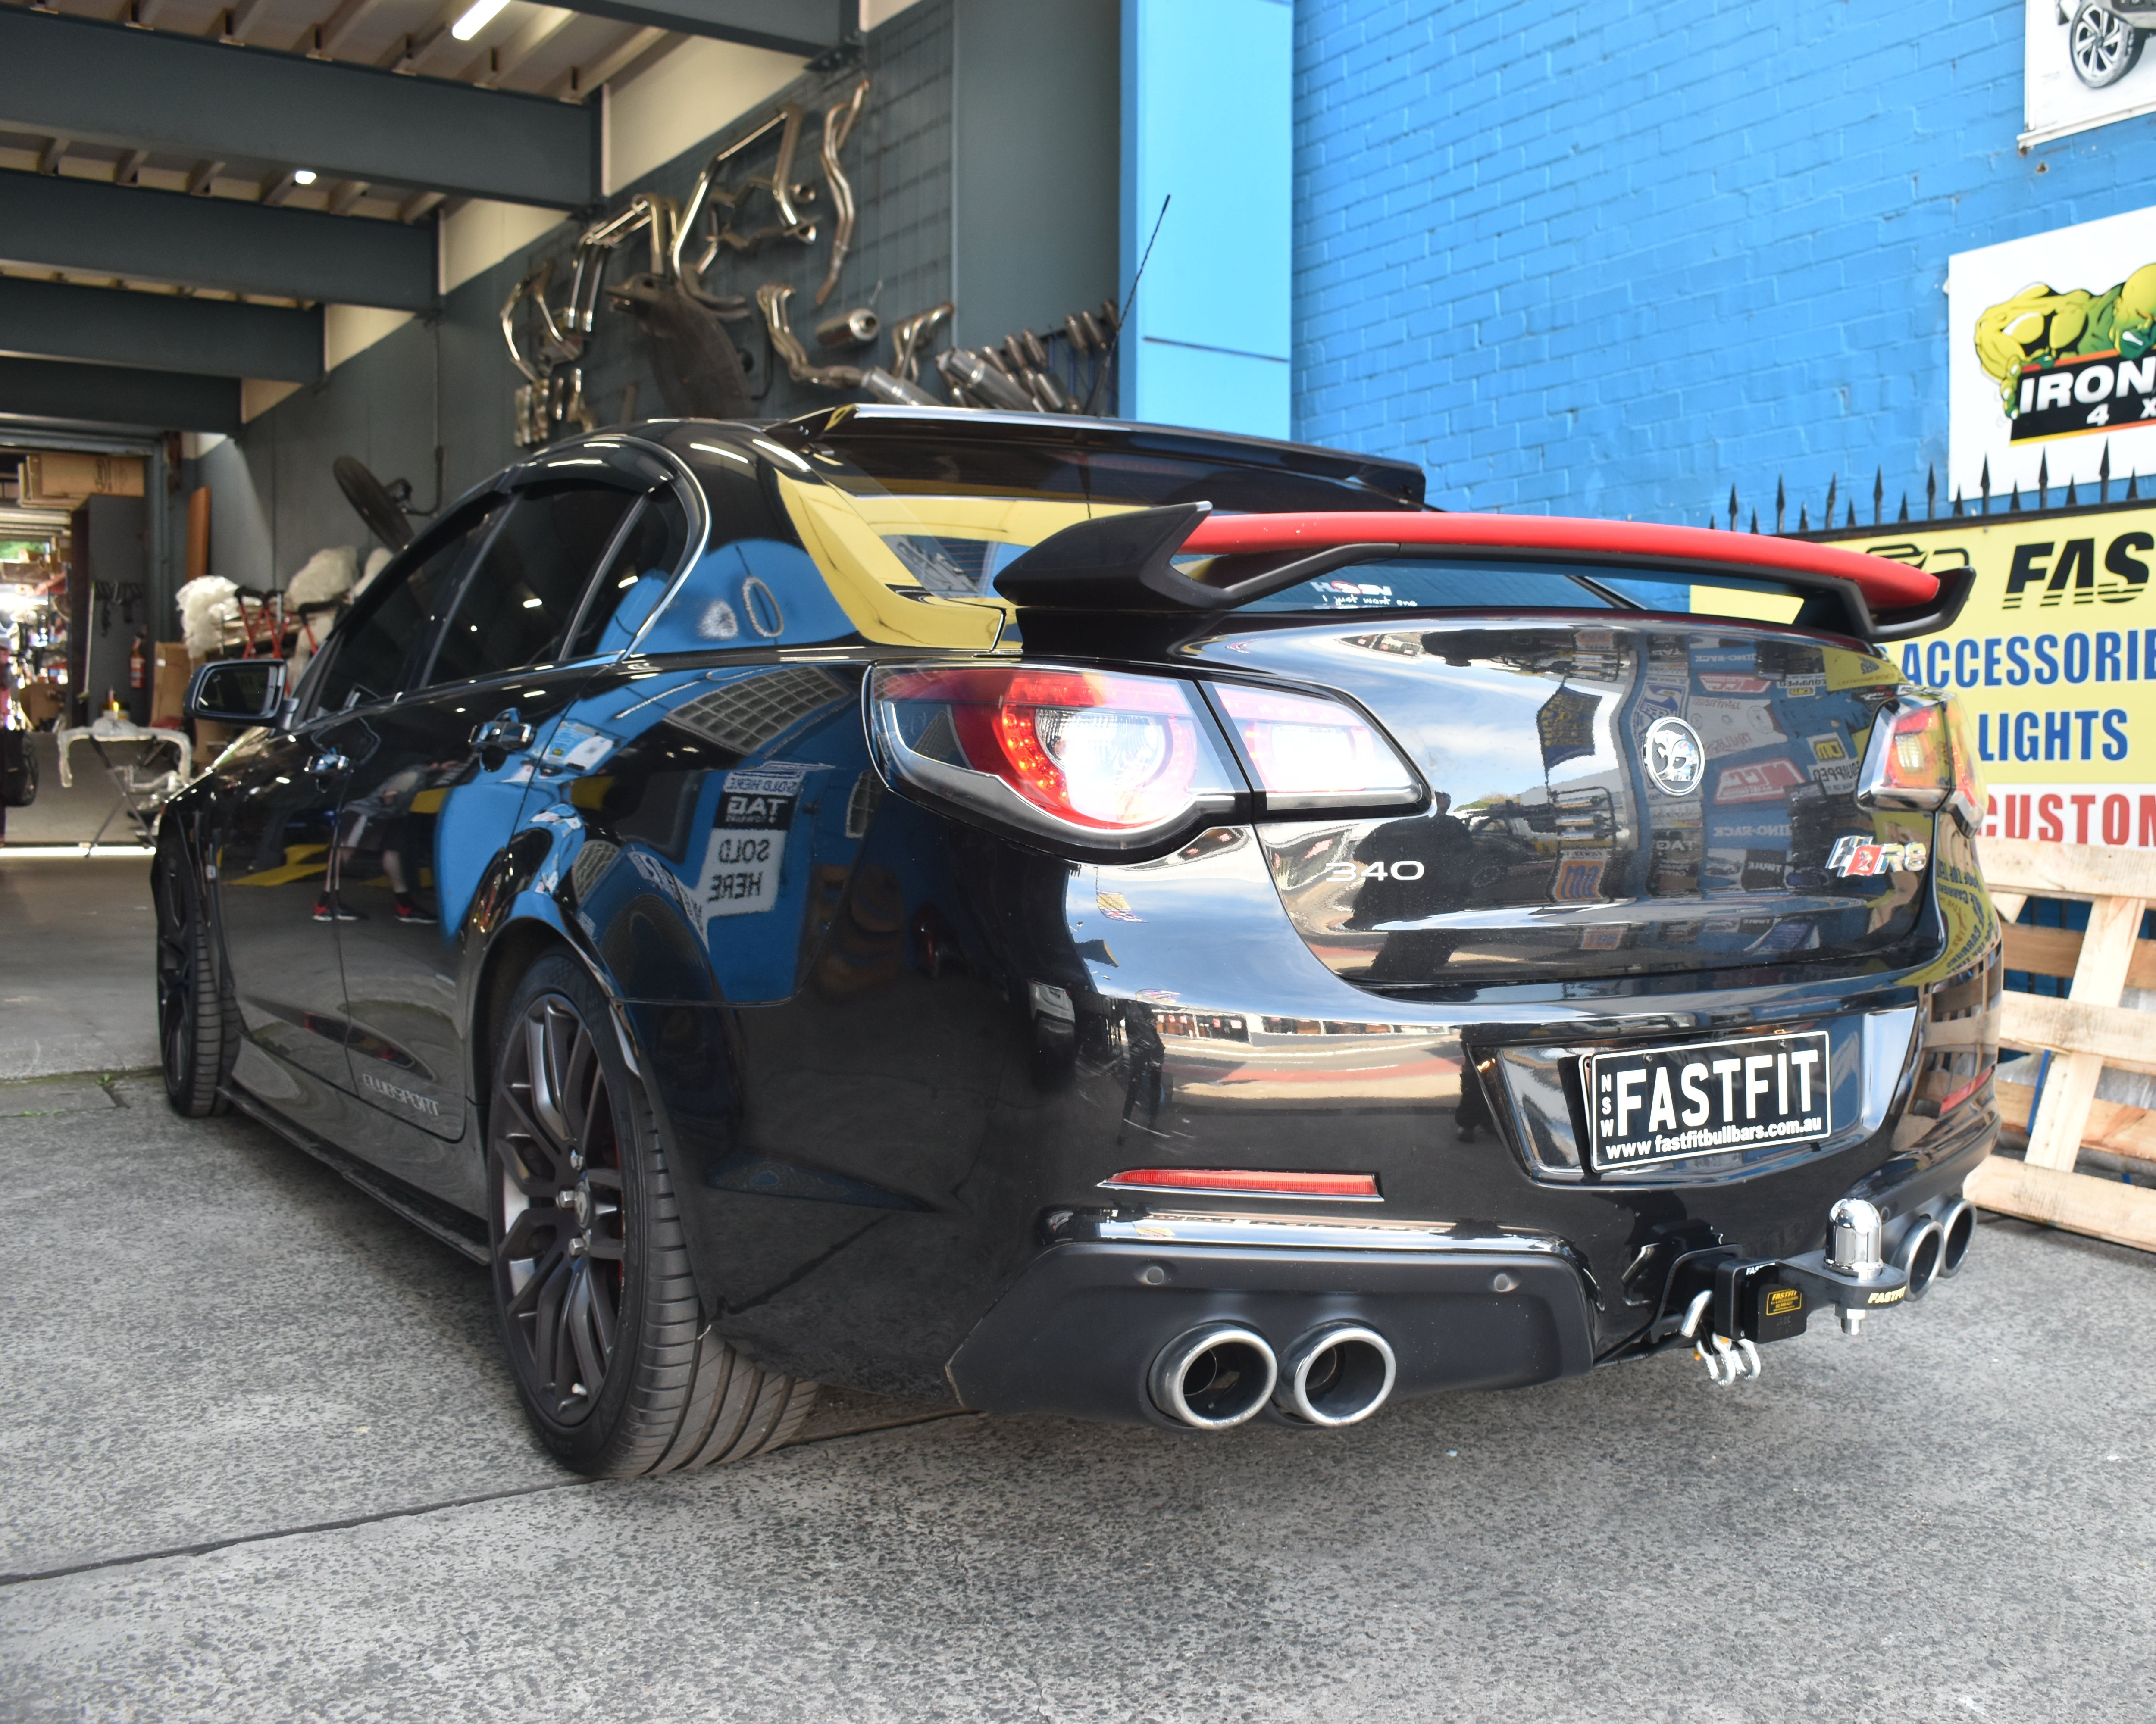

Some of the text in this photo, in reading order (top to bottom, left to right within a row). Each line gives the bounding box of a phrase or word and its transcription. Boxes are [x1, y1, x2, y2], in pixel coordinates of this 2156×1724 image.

[2086, 403, 2109, 426] 4
[1333, 593, 1358, 606] just
[1363, 596, 1391, 605] want
[1978, 709, 2128, 762] LIGHTS
[1326, 861, 1425, 882] 340
[1617, 1049, 1818, 1137] FASTFIT
